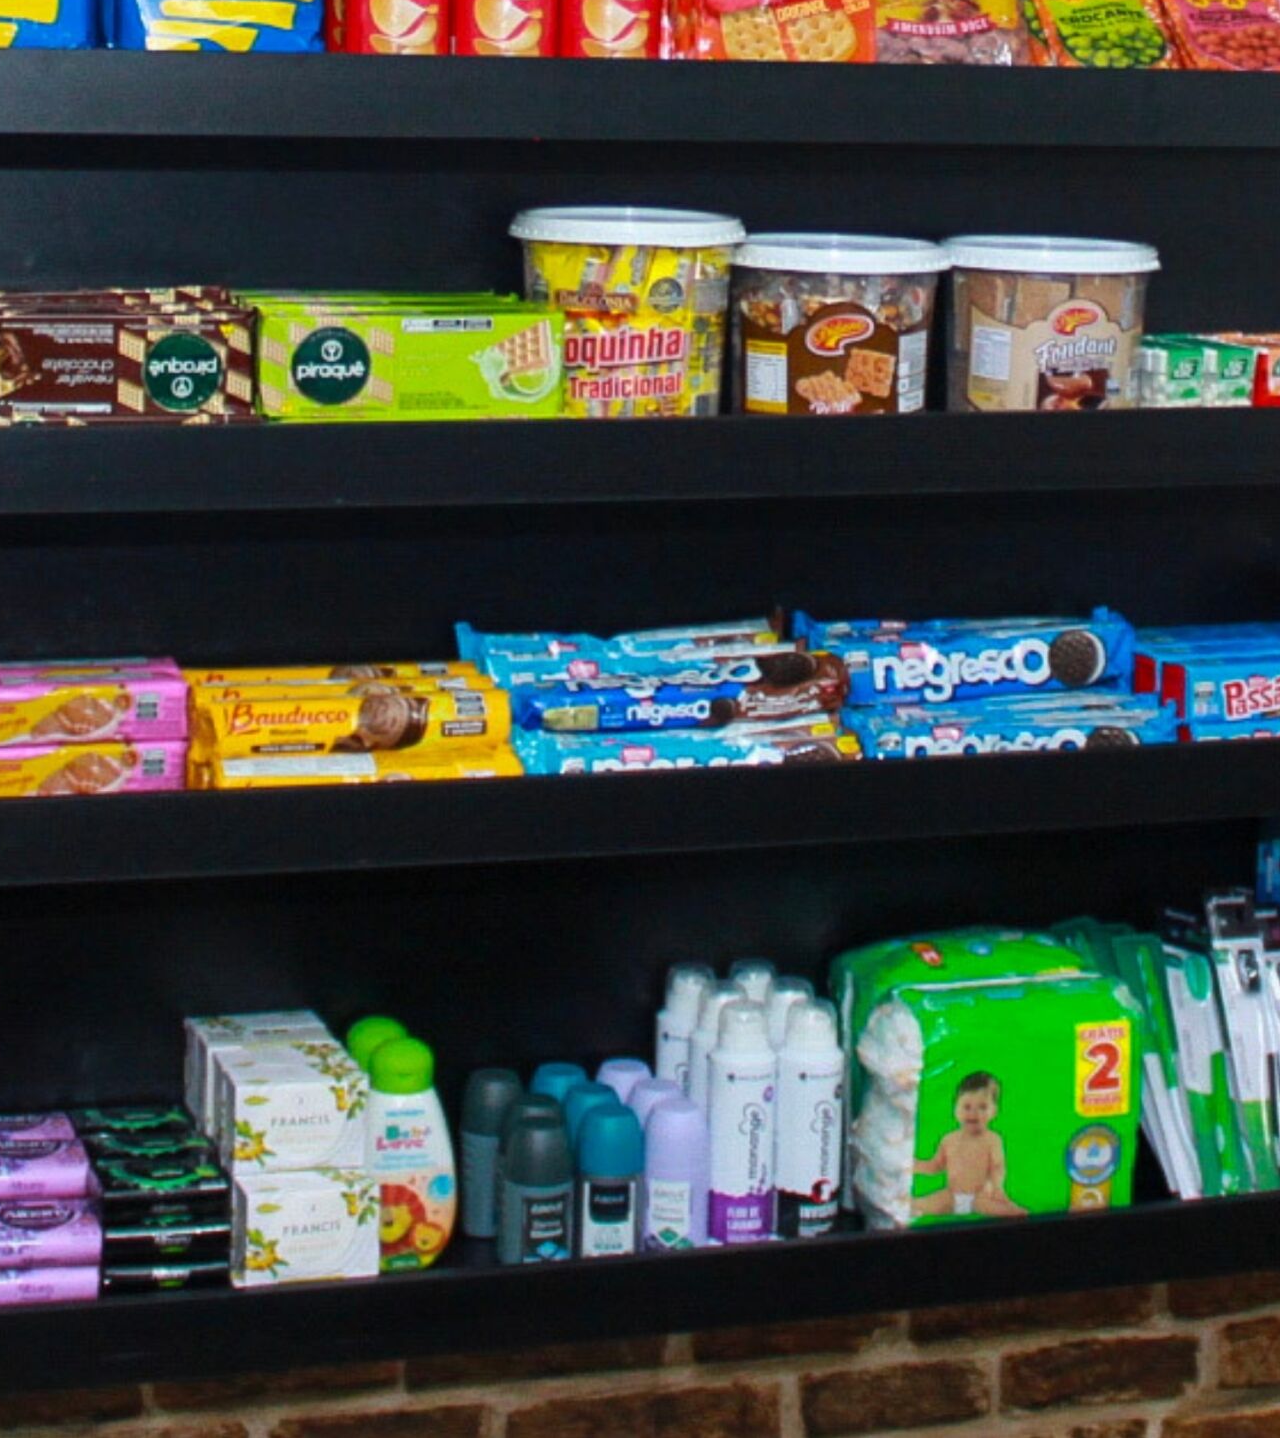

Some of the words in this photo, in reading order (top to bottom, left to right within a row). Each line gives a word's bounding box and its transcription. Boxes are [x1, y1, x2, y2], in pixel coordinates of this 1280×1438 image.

[564, 328, 685, 372] oquinha
[41, 358, 114, 371] chocolate
[149, 356, 218, 377] piraquê
[296, 357, 367, 381] piraquê
[569, 371, 683, 400] Tradicional
[873, 637, 1052, 703] negresco
[223, 701, 349, 736] Bauducco
[1086, 1043, 1120, 1091] 2
[270, 1113, 331, 1129] FRANCIS
[282, 1220, 343, 1238] FRANCIS
